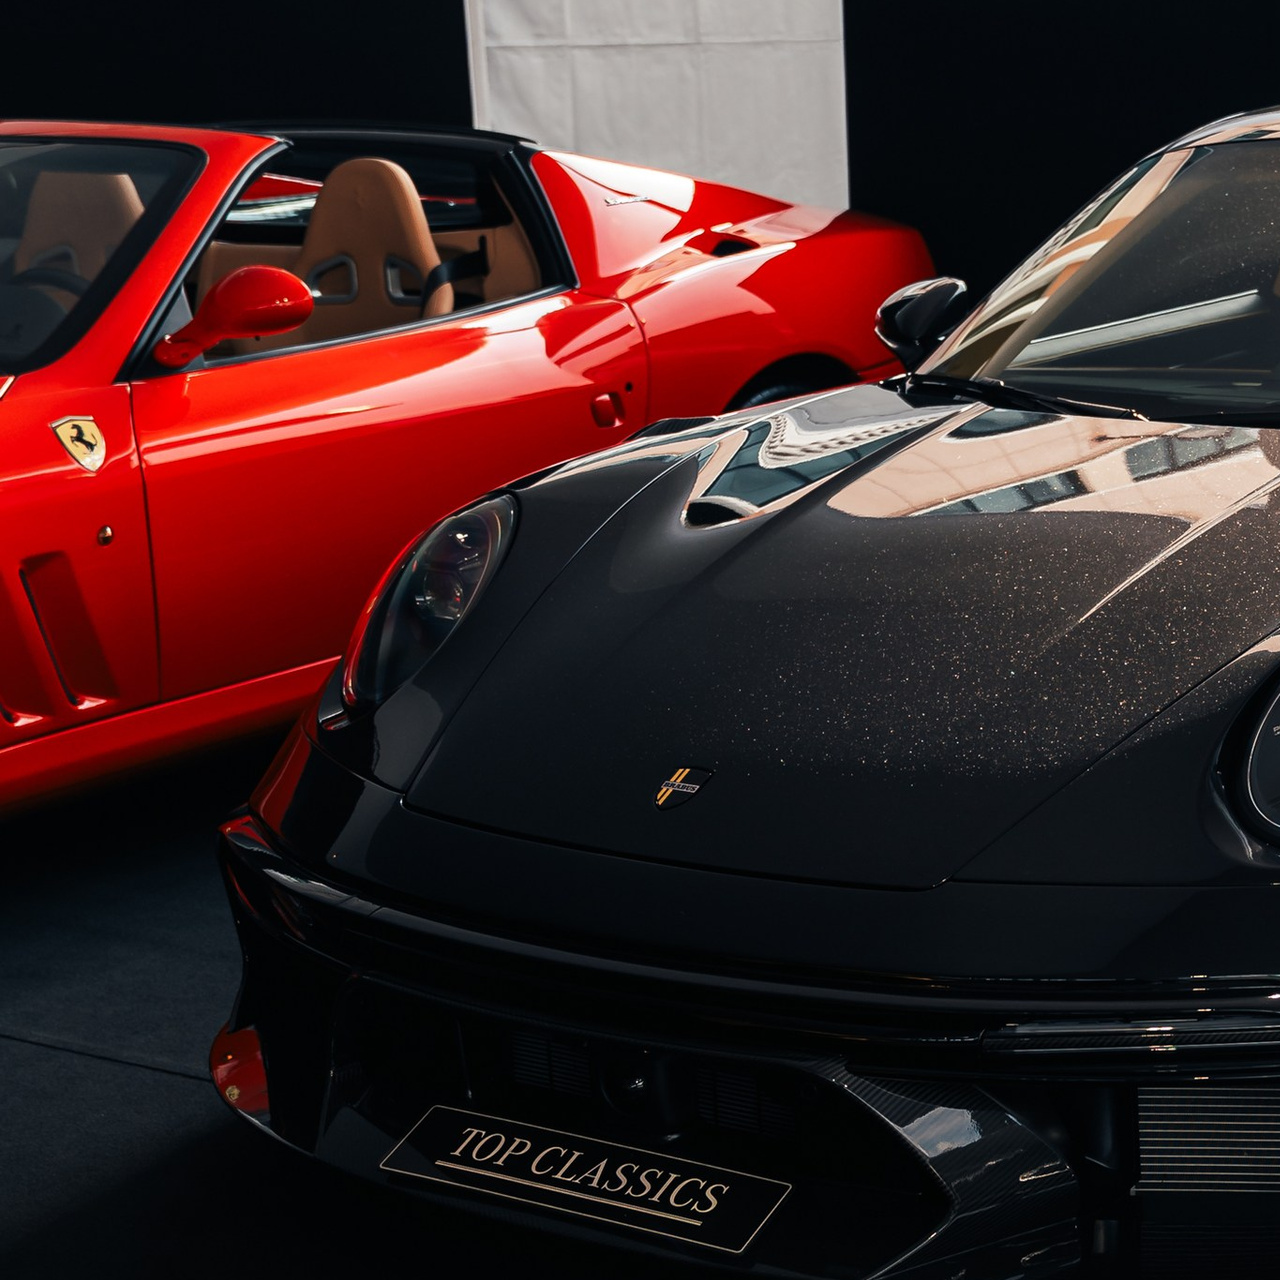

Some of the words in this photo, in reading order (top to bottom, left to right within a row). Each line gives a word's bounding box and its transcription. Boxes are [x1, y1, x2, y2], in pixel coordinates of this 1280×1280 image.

[662, 781, 698, 792] BRABUS
[450, 1127, 532, 1166] TOP
[530, 1146, 730, 1213] CLASSICS
